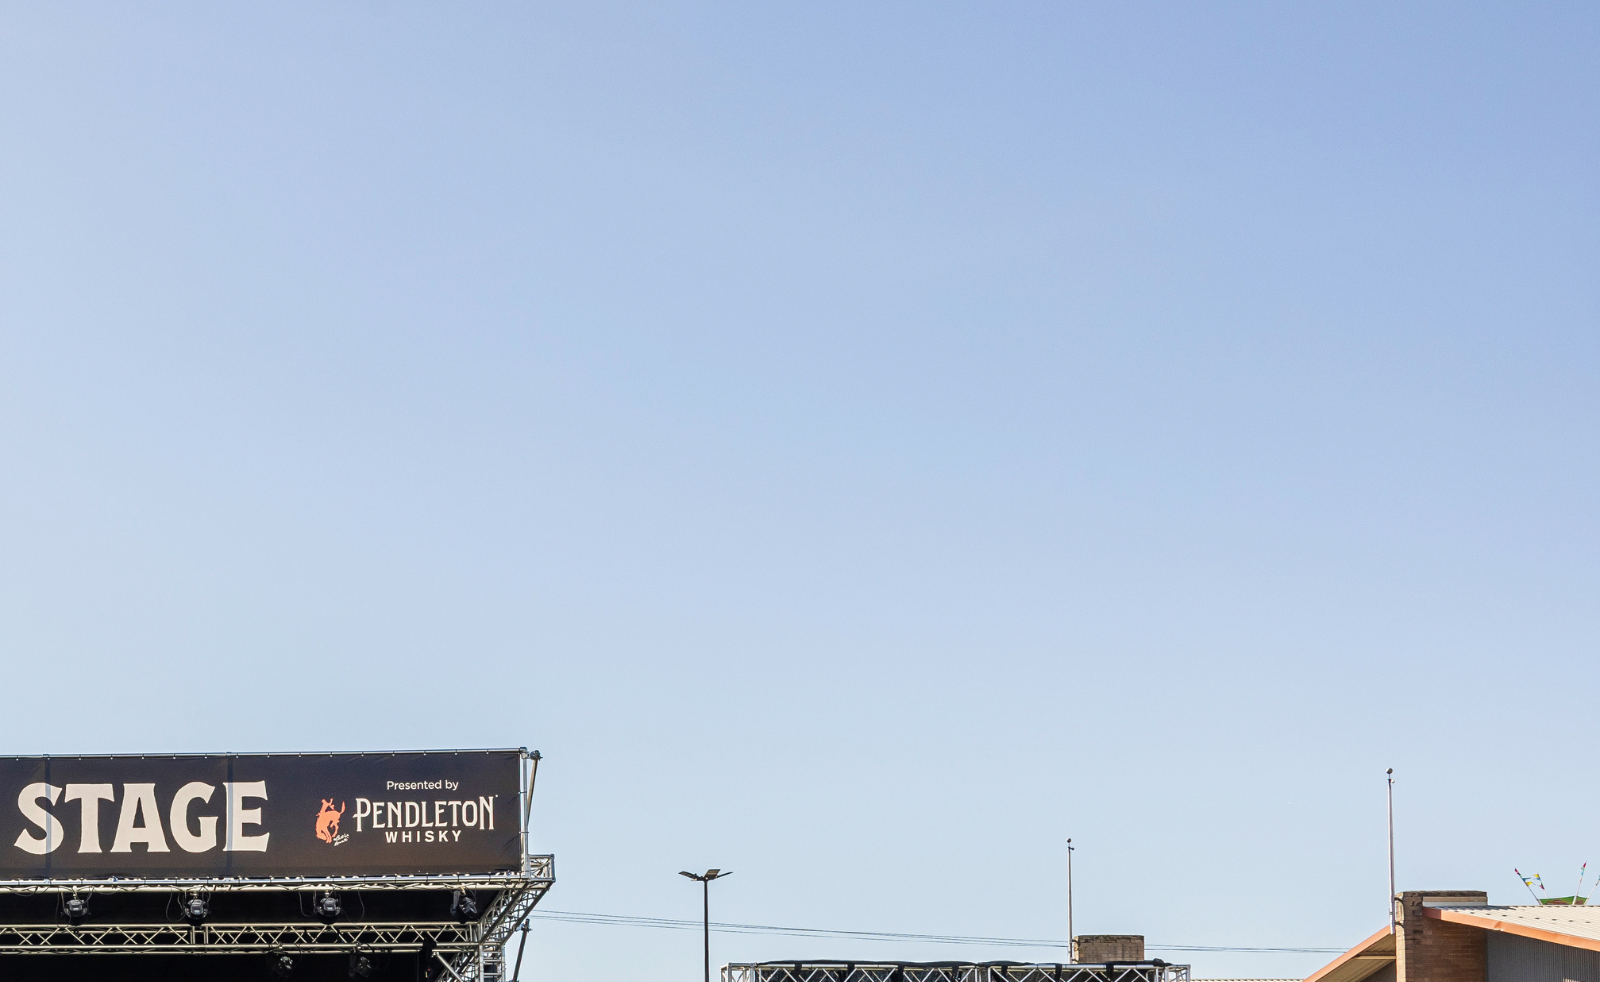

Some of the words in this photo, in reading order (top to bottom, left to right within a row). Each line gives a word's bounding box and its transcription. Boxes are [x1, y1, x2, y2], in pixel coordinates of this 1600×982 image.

[386, 779, 442, 790] Presented
[445, 779, 460, 792] by
[13, 780, 270, 855] STAGE
[353, 795, 495, 831] PENDLETON
[384, 829, 462, 844] WHISKY
